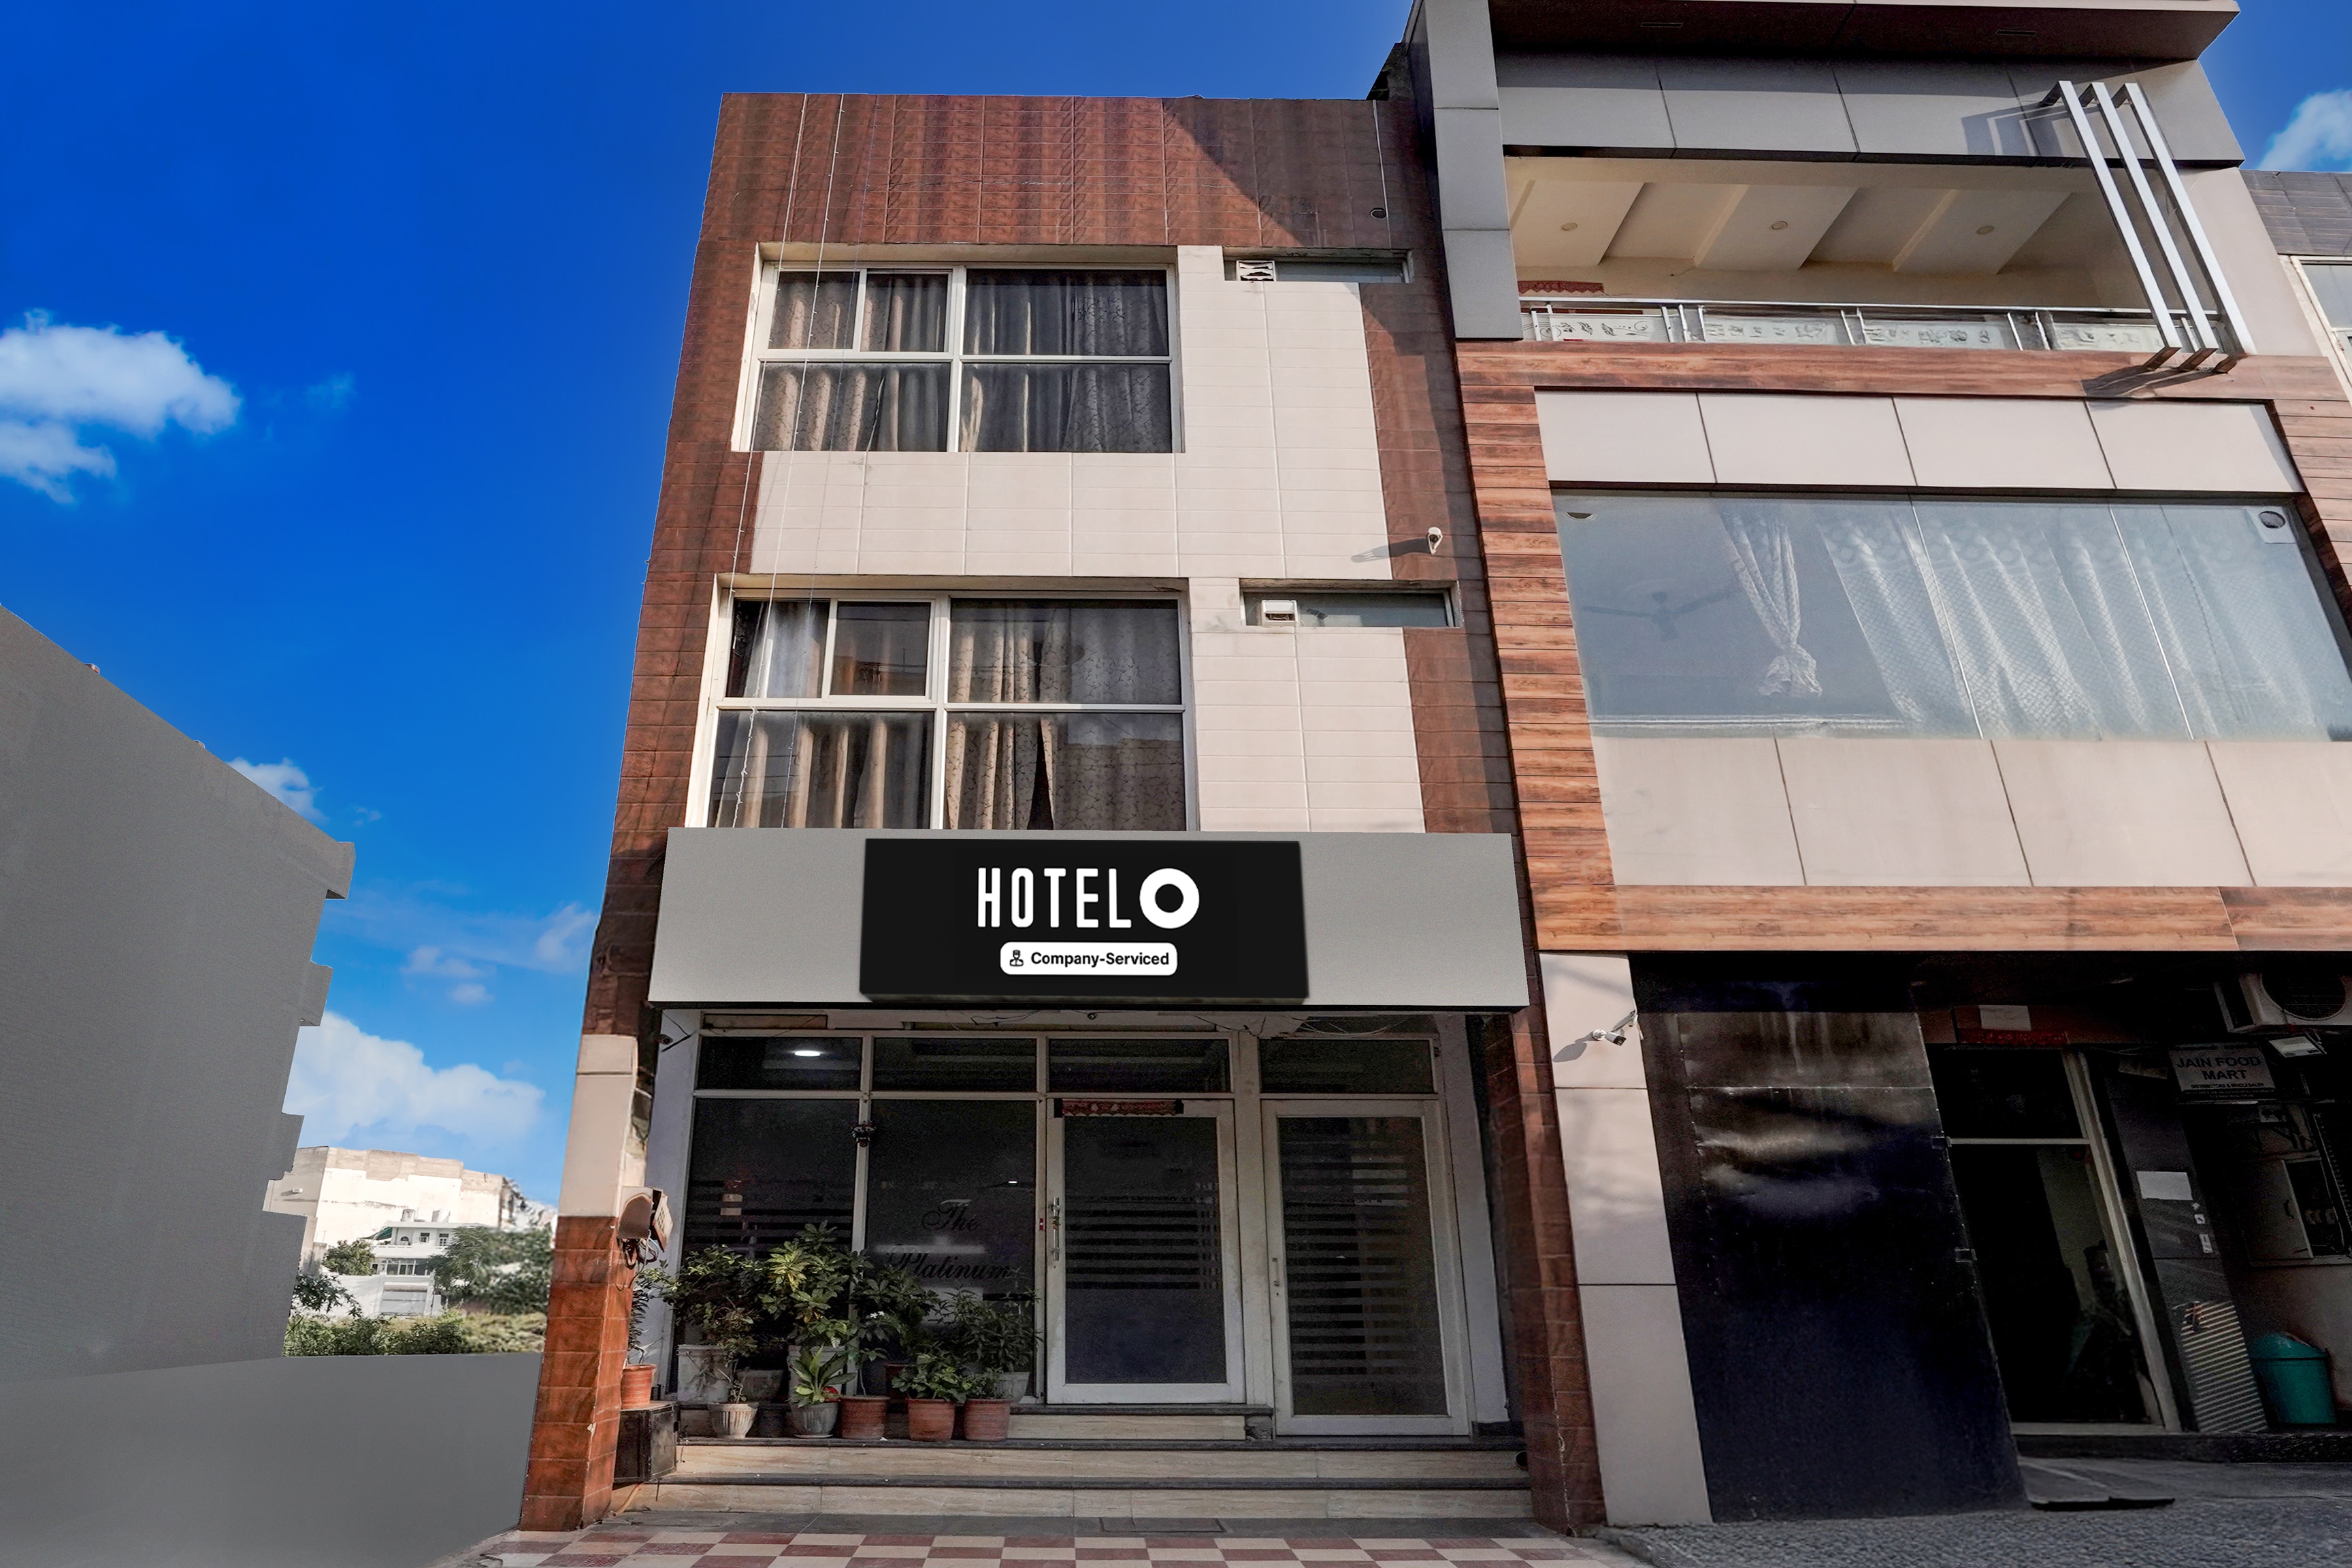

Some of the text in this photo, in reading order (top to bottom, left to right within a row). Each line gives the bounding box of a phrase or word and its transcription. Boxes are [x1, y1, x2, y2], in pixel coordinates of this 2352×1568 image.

[1030, 952, 1169, 967] Company-Serviced
[2176, 1056, 2261, 1068] JAIN FOOD
[2202, 1069, 2247, 1080] MART
